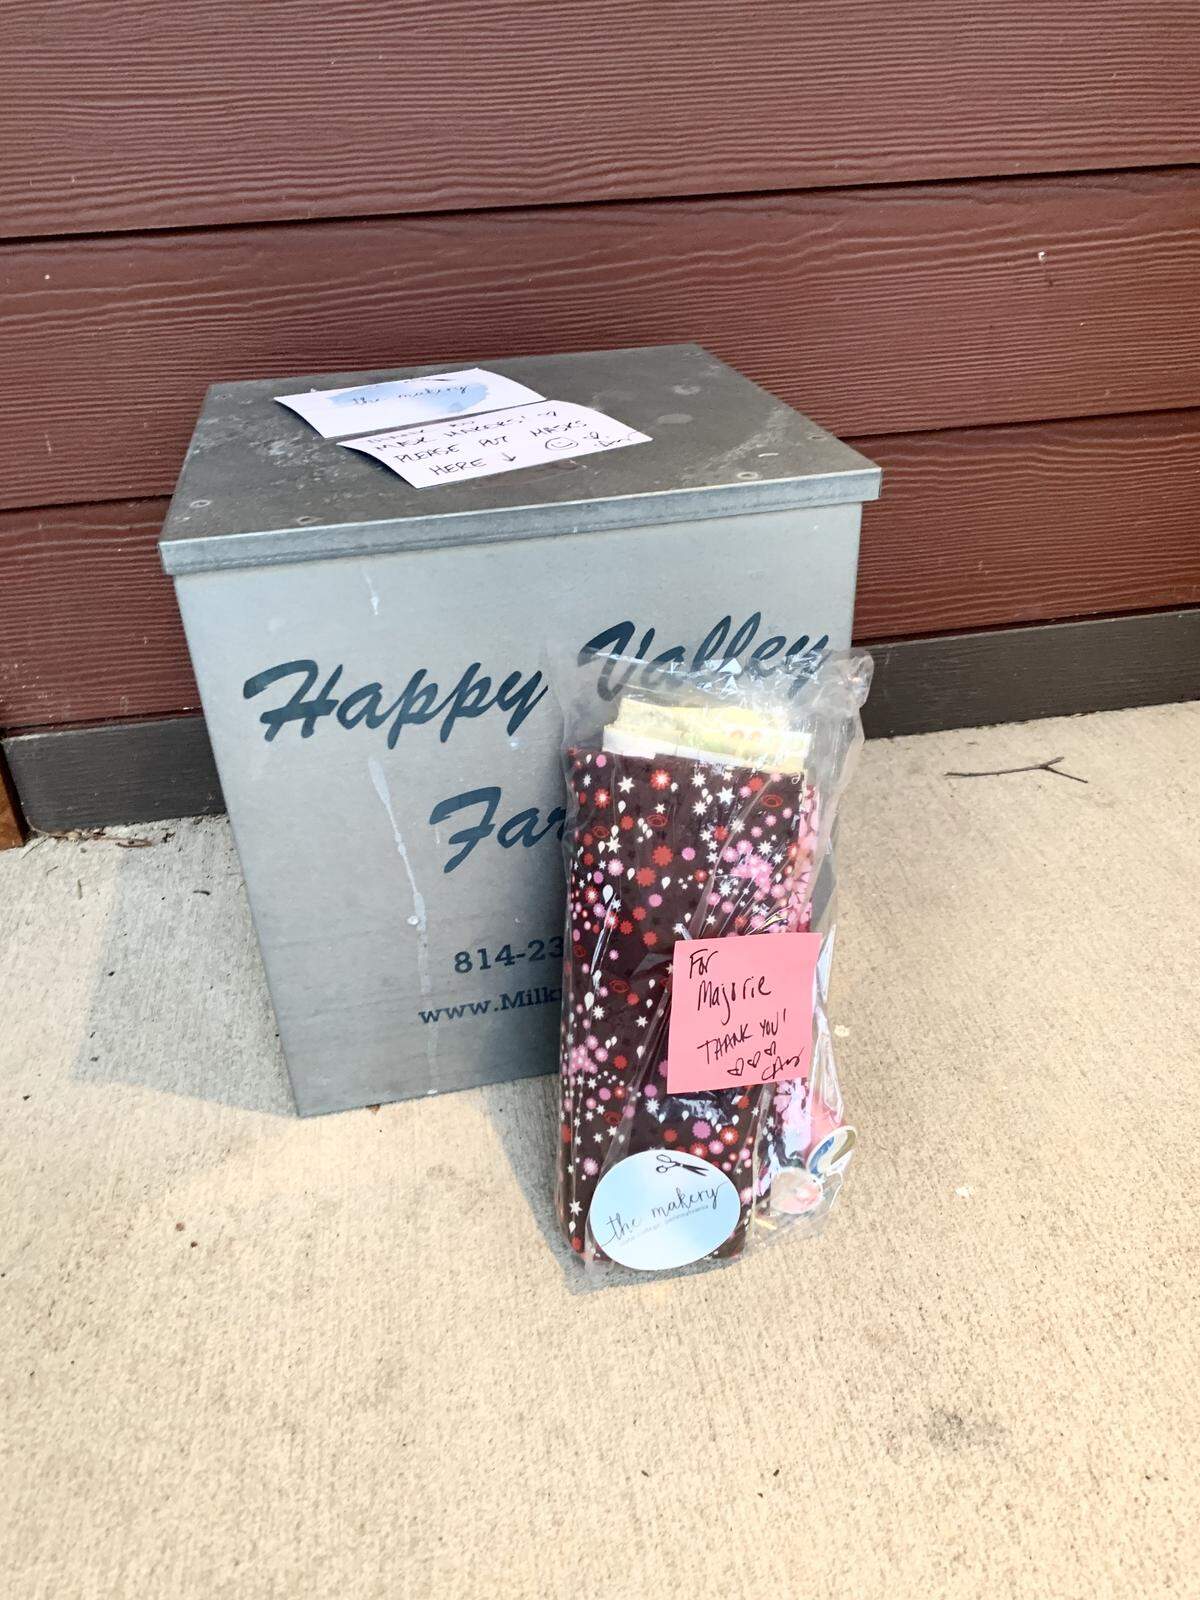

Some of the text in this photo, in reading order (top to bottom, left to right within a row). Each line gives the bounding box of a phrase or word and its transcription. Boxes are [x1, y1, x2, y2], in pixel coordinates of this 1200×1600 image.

[393, 444, 460, 463] PLEASE
[478, 435, 510, 448] PUT
[429, 458, 488, 476] HERE
[243, 611, 831, 749] Happy Valley
[429, 786, 566, 873] Far
[454, 935, 564, 974] 814-23
[689, 948, 719, 979] For
[417, 986, 564, 1024] www.Milk
[697, 975, 772, 1026] Majorie
[696, 1023, 753, 1064] THANK
[602, 1212, 641, 1246] the
[651, 1182, 728, 1217] makery
